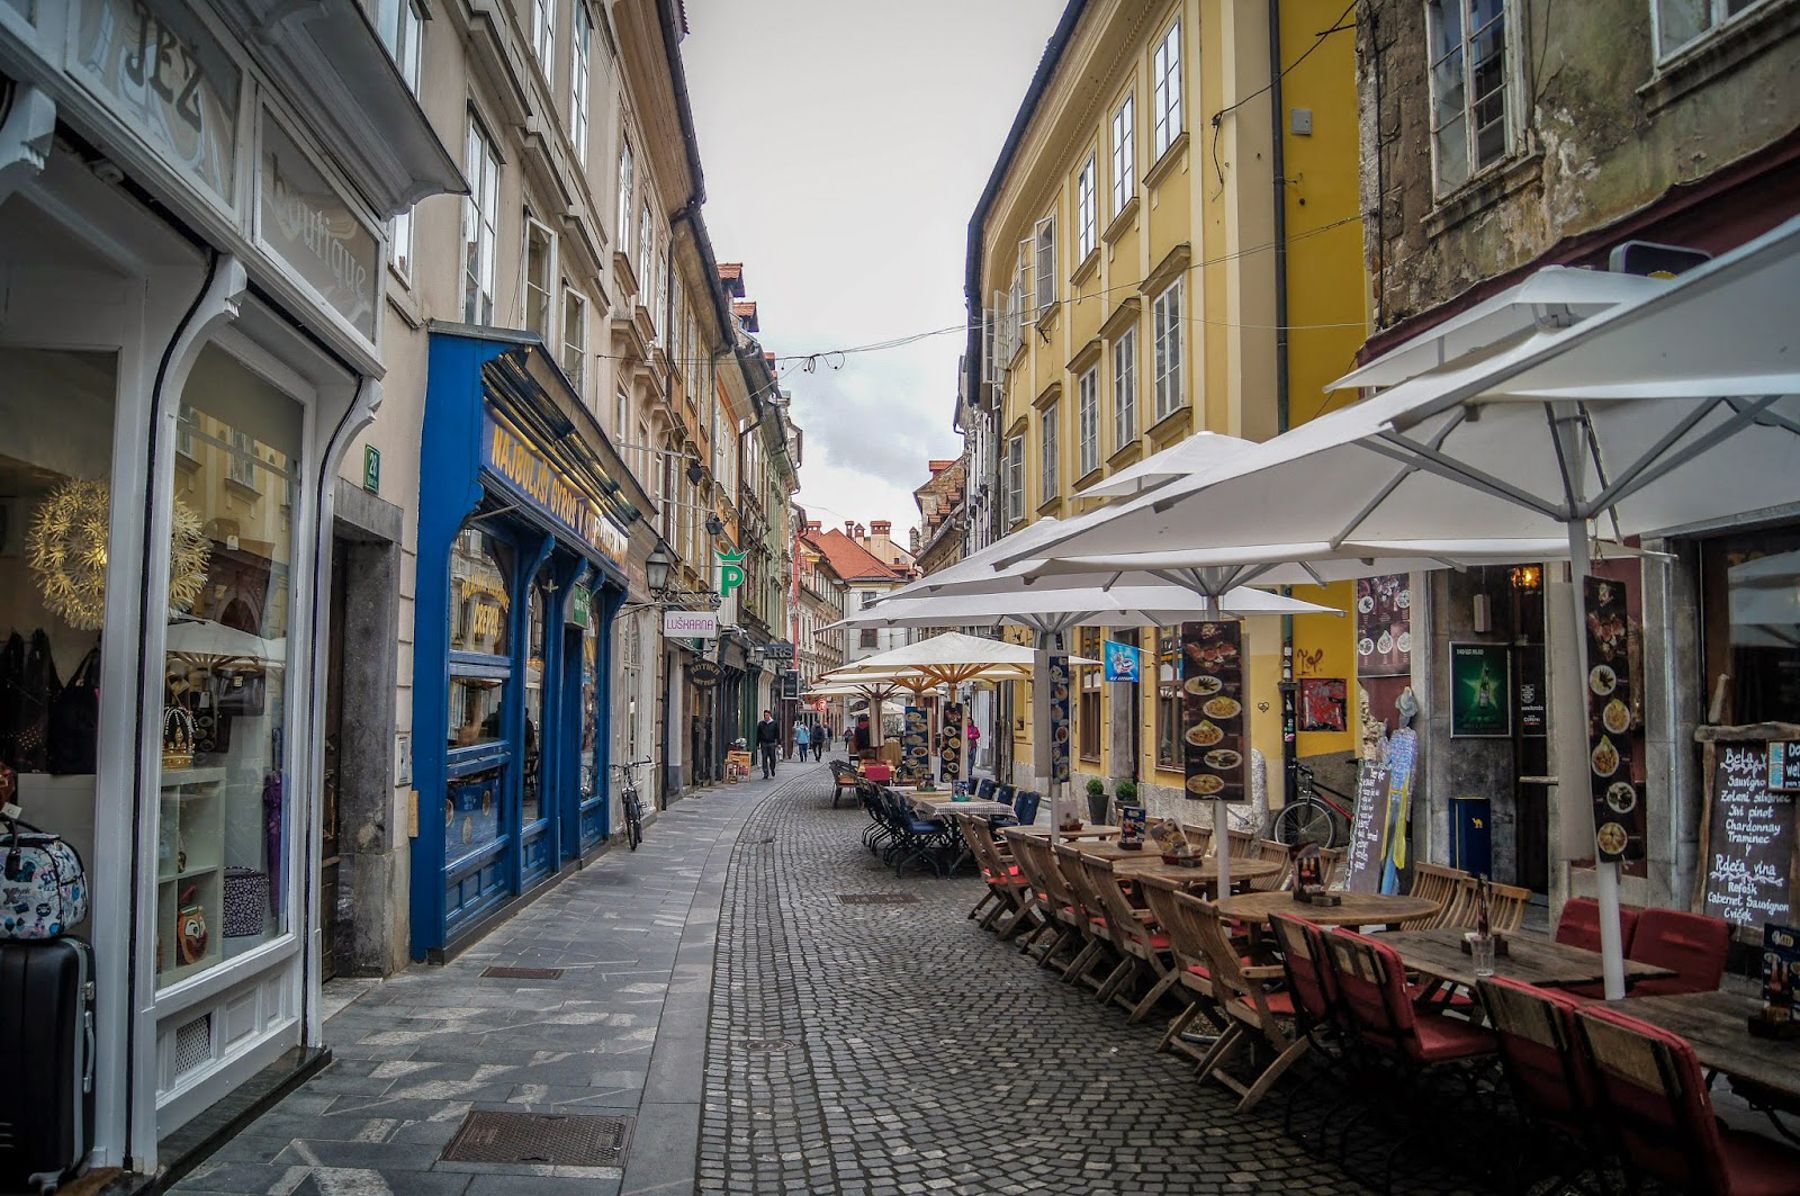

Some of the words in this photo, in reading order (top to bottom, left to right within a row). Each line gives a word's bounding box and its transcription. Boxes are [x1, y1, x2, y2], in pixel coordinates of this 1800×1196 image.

[551, 478, 576, 529] GYROS
[1725, 747, 1754, 765] Bela
[1727, 775, 1766, 792] Sauvigno
[1720, 789, 1750, 802] Zeleni
[1748, 805, 1774, 821] pinot
[1725, 819, 1780, 835] Chardonnay
[1727, 831, 1770, 844] Traminec
[1715, 853, 1745, 873] Rdeča
[1753, 860, 1776, 876] vina
[1707, 891, 1743, 906] Cabernet
[1746, 896, 1789, 916] Sauvignon
[1724, 907, 1752, 921] Cviček
